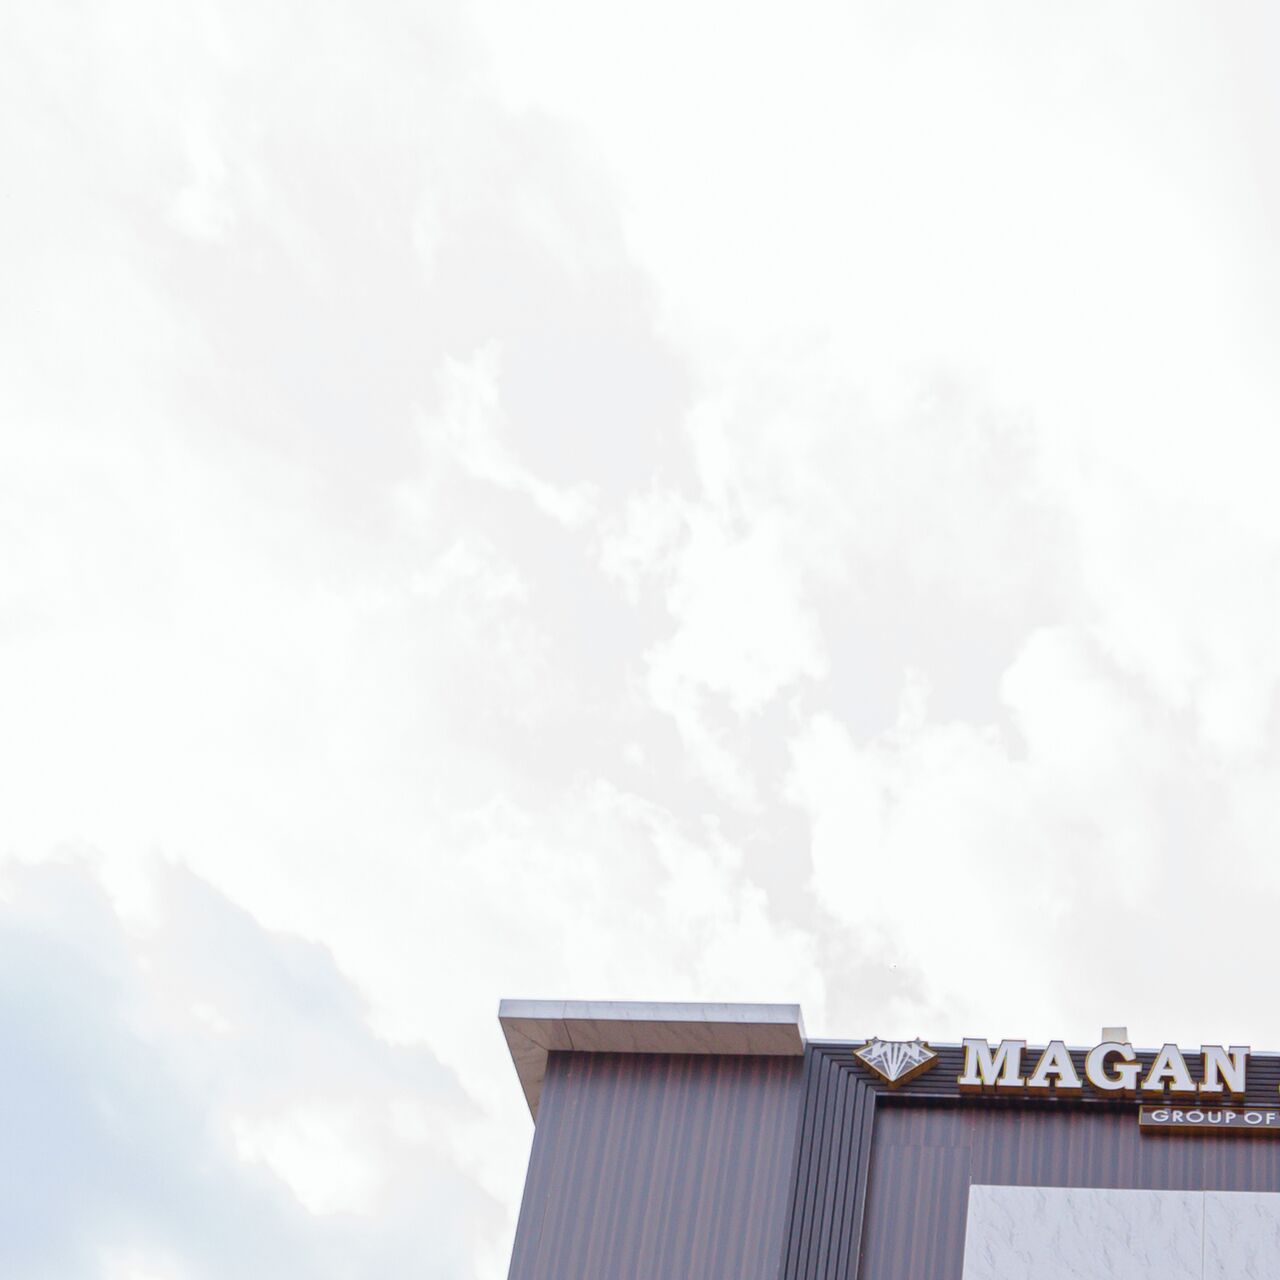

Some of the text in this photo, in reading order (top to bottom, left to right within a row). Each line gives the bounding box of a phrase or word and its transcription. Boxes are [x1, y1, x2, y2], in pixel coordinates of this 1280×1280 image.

[957, 1037, 1251, 1093] MAGAN
[1150, 1109, 1237, 1124] GROUP
[1243, 1111, 1277, 1125] OF
